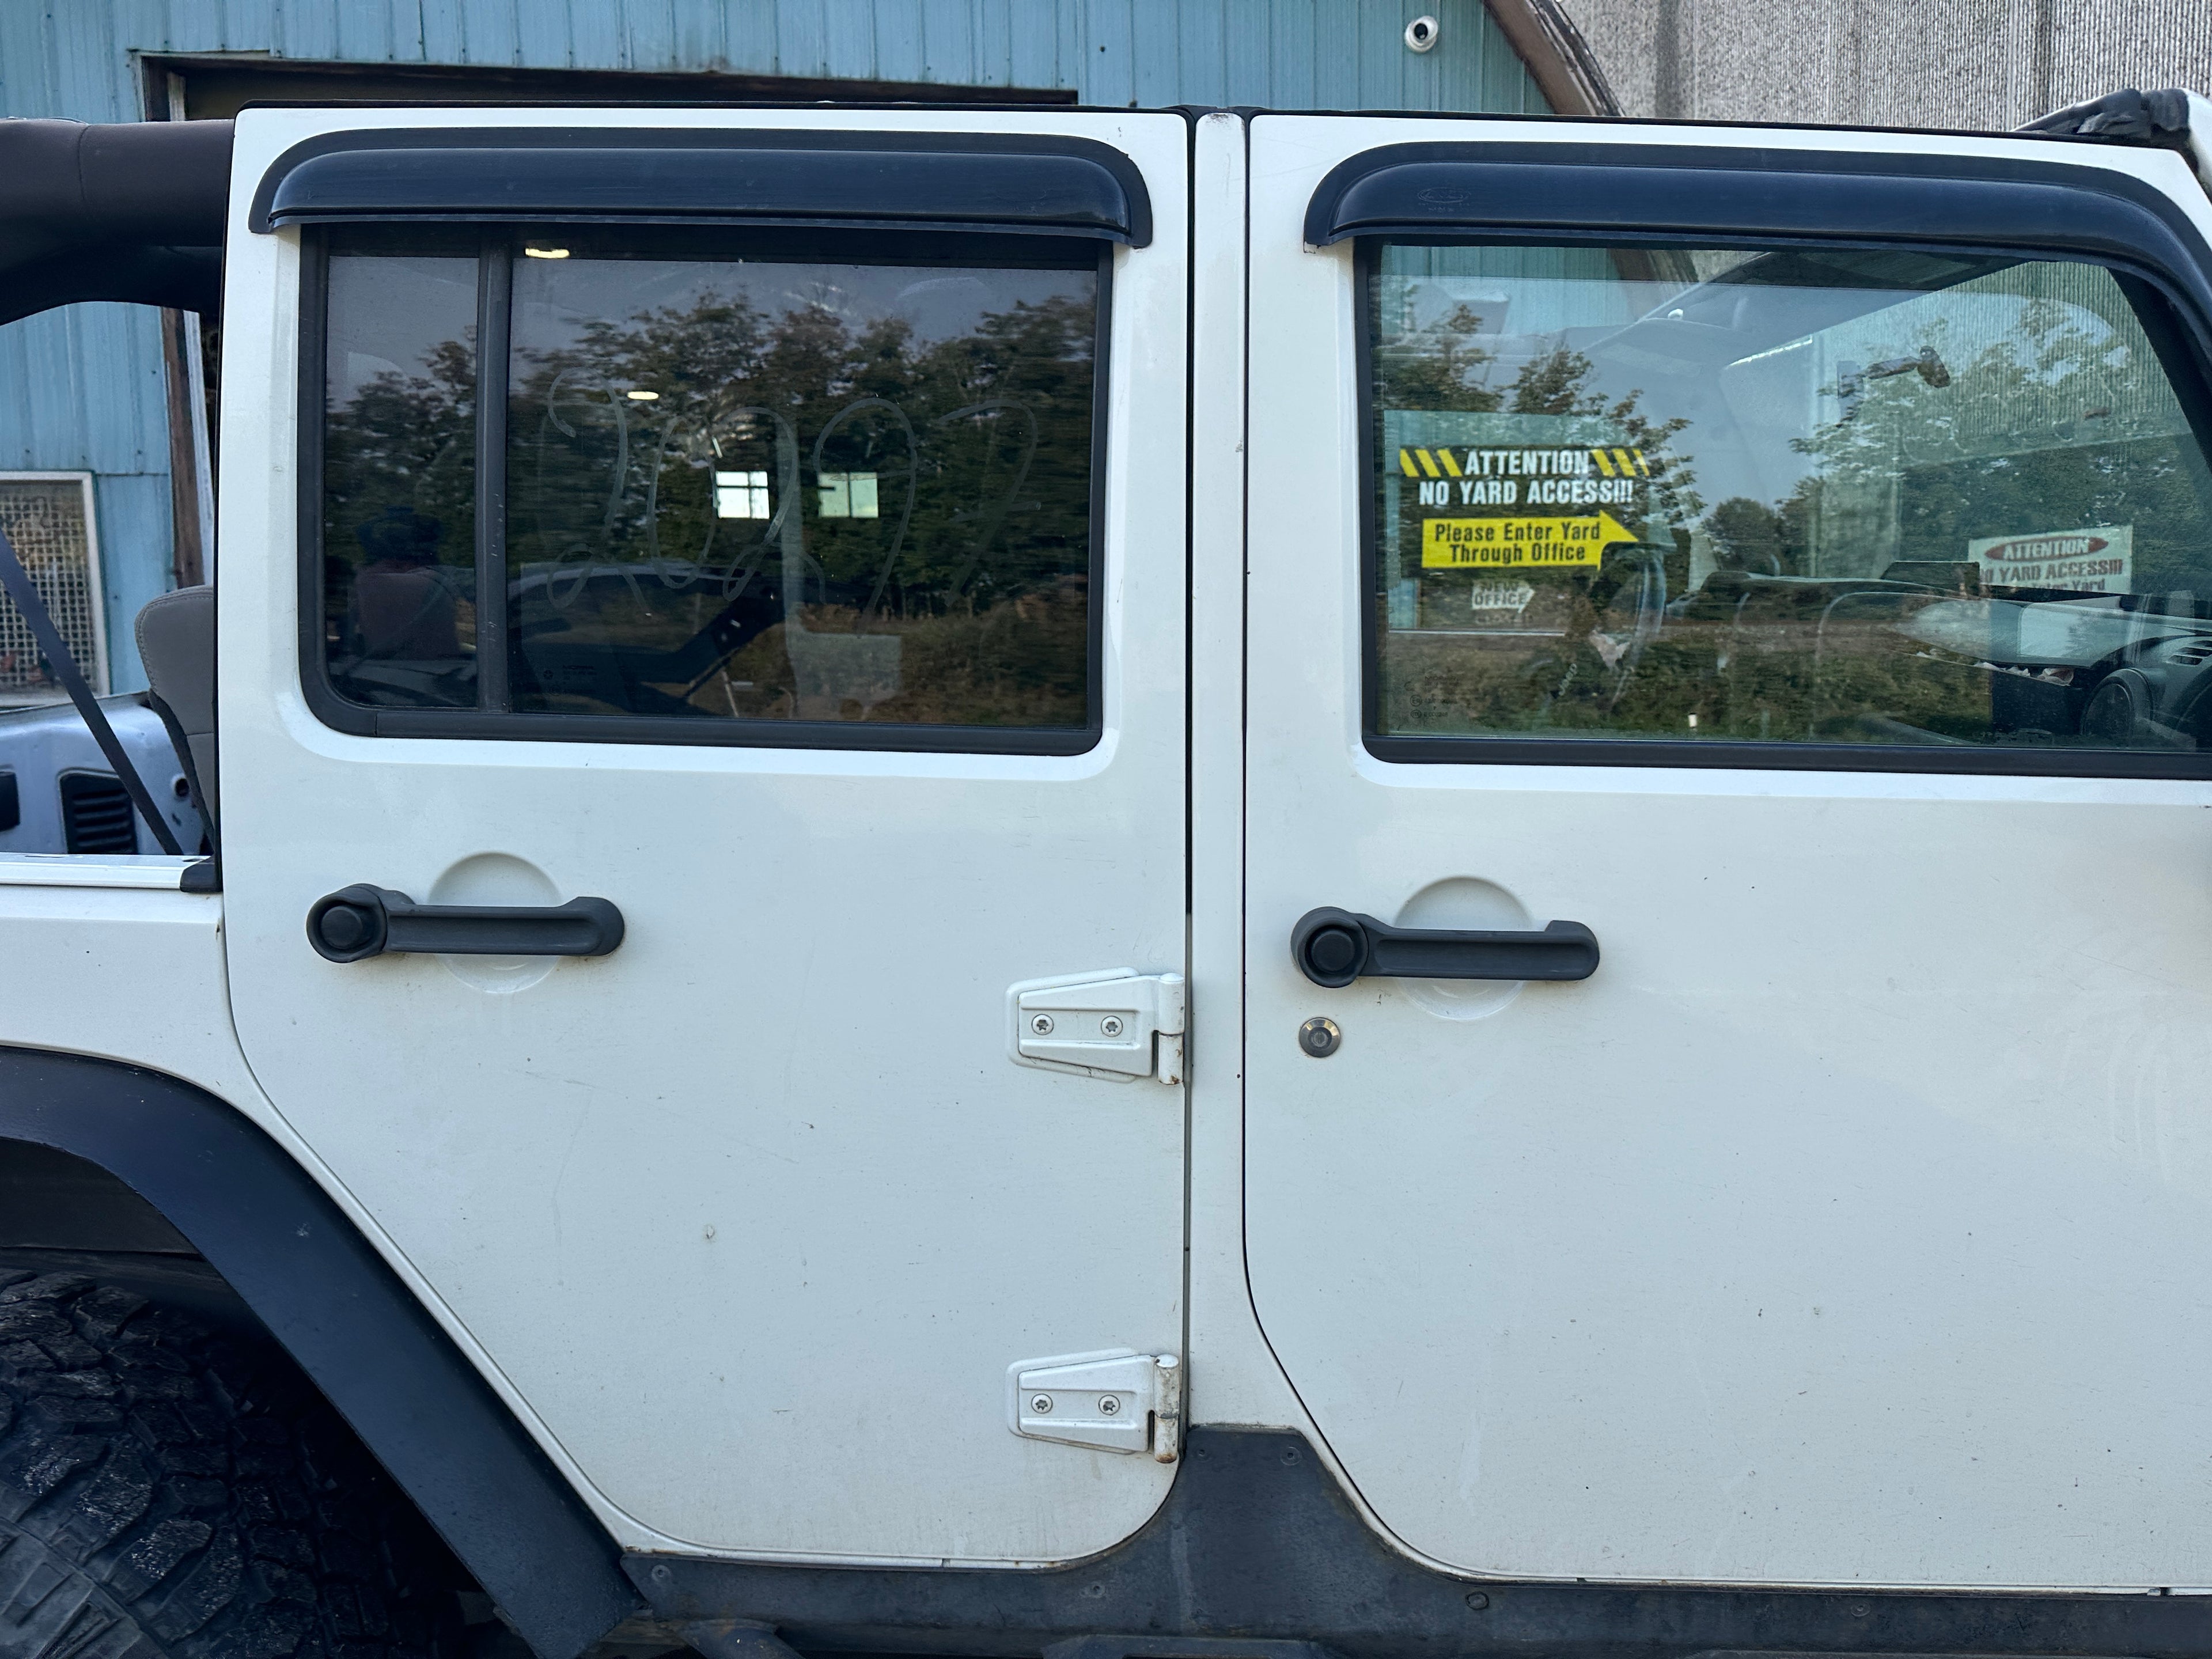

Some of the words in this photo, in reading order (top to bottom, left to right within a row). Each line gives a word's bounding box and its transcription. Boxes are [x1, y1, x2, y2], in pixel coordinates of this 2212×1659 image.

[1464, 450, 1590, 475] ATTENTION
[1419, 480, 1450, 505] NO
[1460, 480, 1517, 505] YARD
[1527, 479, 1634, 504] ACCESS!!!
[1435, 524, 1495, 542] Please
[1503, 522, 1553, 541] Enter
[1561, 522, 1601, 540] Yard
[1449, 543, 1522, 564] Through
[1531, 543, 1586, 561] Office
[2002, 539, 2089, 559] ATTENTION
[2000, 564, 2041, 582] YARD
